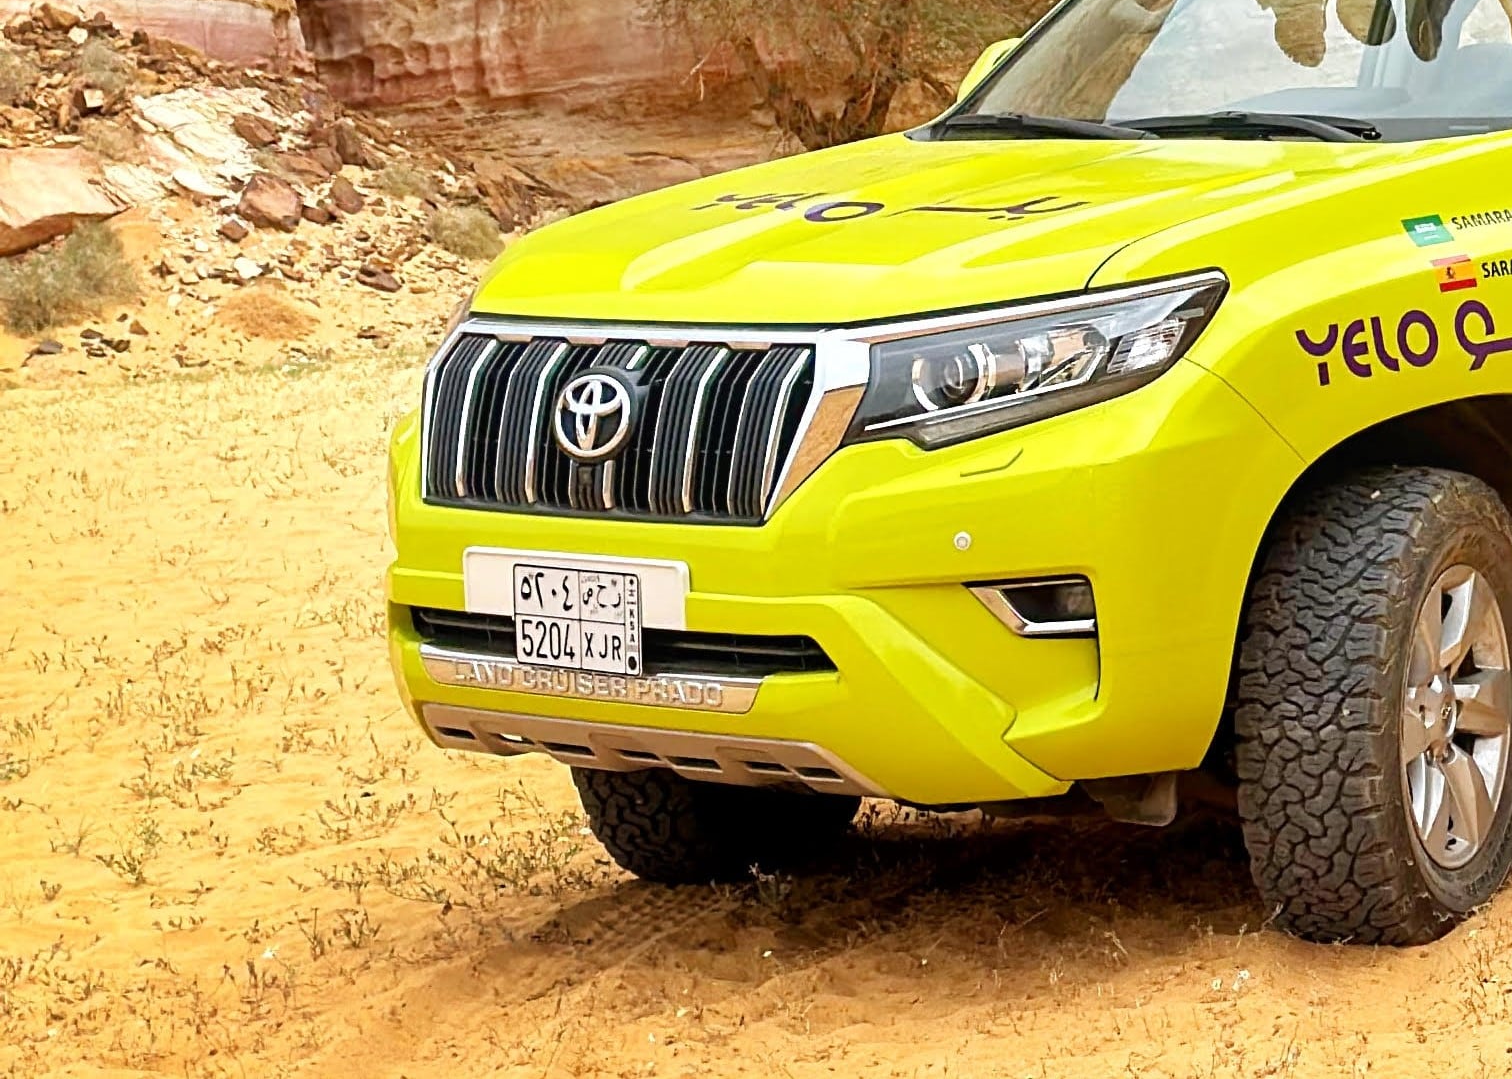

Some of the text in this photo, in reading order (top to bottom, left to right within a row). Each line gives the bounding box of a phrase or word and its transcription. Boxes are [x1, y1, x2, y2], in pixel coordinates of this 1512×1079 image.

[1295, 309, 1439, 387] YELO
[520, 572, 573, 611] ٥٢٠٤
[521, 619, 576, 662] 5204
[453, 660, 724, 708] LAND CRUISER PRADO
